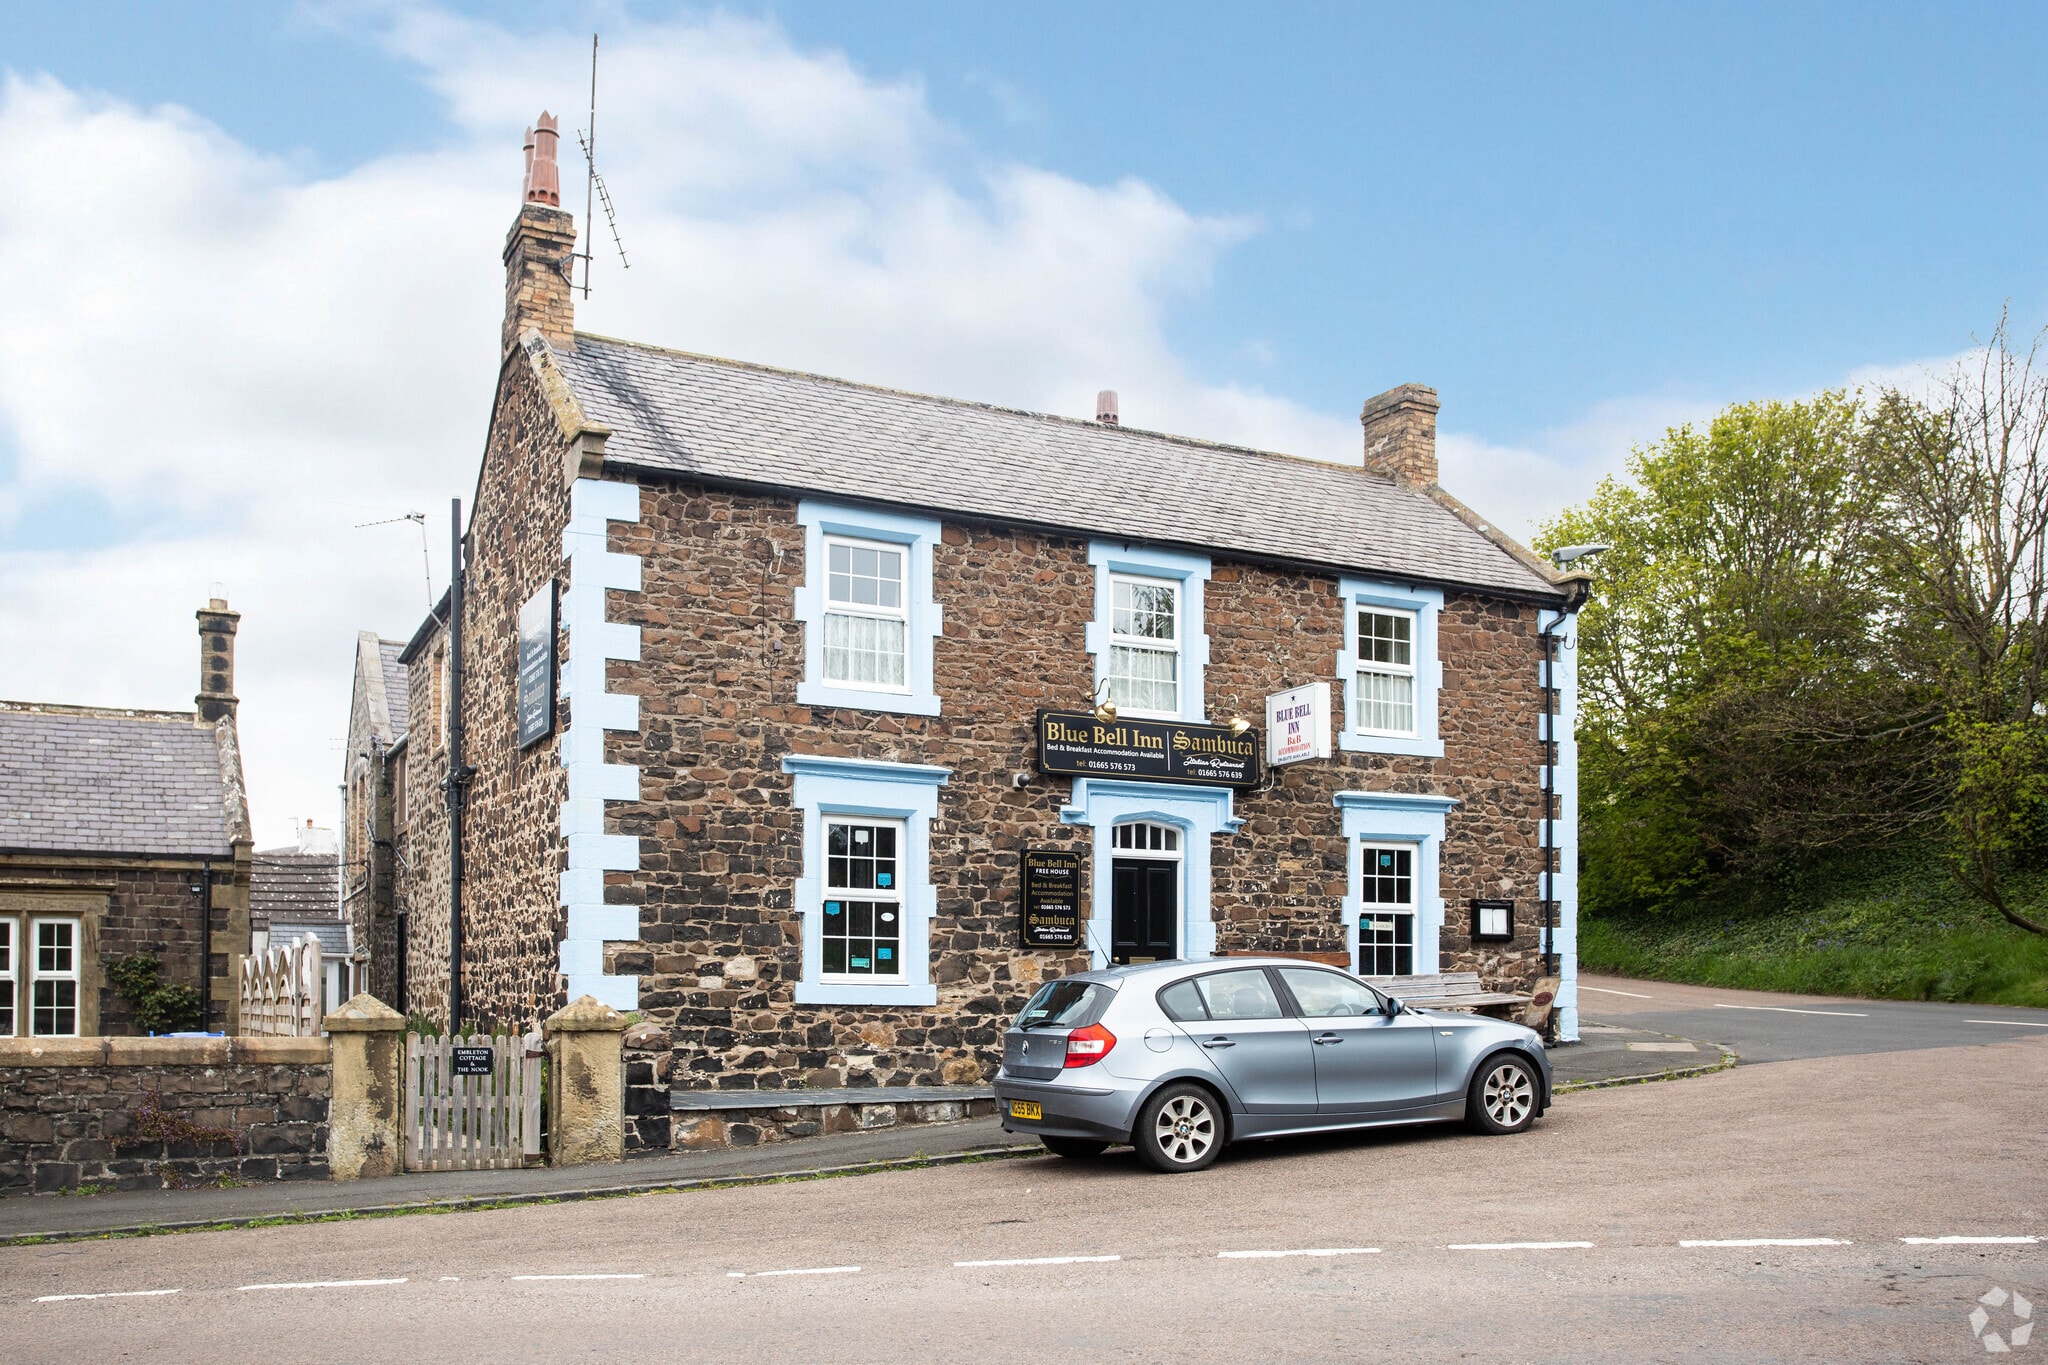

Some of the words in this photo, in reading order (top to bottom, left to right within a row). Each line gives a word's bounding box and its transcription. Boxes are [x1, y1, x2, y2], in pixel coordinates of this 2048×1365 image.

[1276, 707, 1293, 723] BLUE
[1294, 703, 1311, 719] BELL
[1288, 721, 1300, 735] INN
[1046, 722, 1088, 743] Blue
[1093, 726, 1128, 746] Bell
[1132, 729, 1164, 749] Inn
[1287, 735, 1301, 745] B&B
[1172, 730, 1254, 756] Sambuca
[1046, 743, 1058, 751] Bed
[1066, 744, 1092, 753] Breakfast
[1093, 747, 1139, 757] Accommodation
[1140, 751, 1165, 759] Available
[1088, 760, 1108, 769] 01665
[1110, 762, 1122, 770] 576
[1123, 763, 1136, 771] 573
[1183, 756, 1209, 766] Italian
[1210, 758, 1245, 768] Restaurant
[1198, 769, 1217, 777] 01665
[1218, 770, 1230, 778] 576
[1231, 771, 1243, 779] 639
[1028, 858, 1045, 867] Blue
[1047, 859, 1062, 868] Bell
[1064, 860, 1077, 868] Inn
[1028, 913, 1075, 925] Sambuca
[1027, 1102, 1040, 1116] BKX
